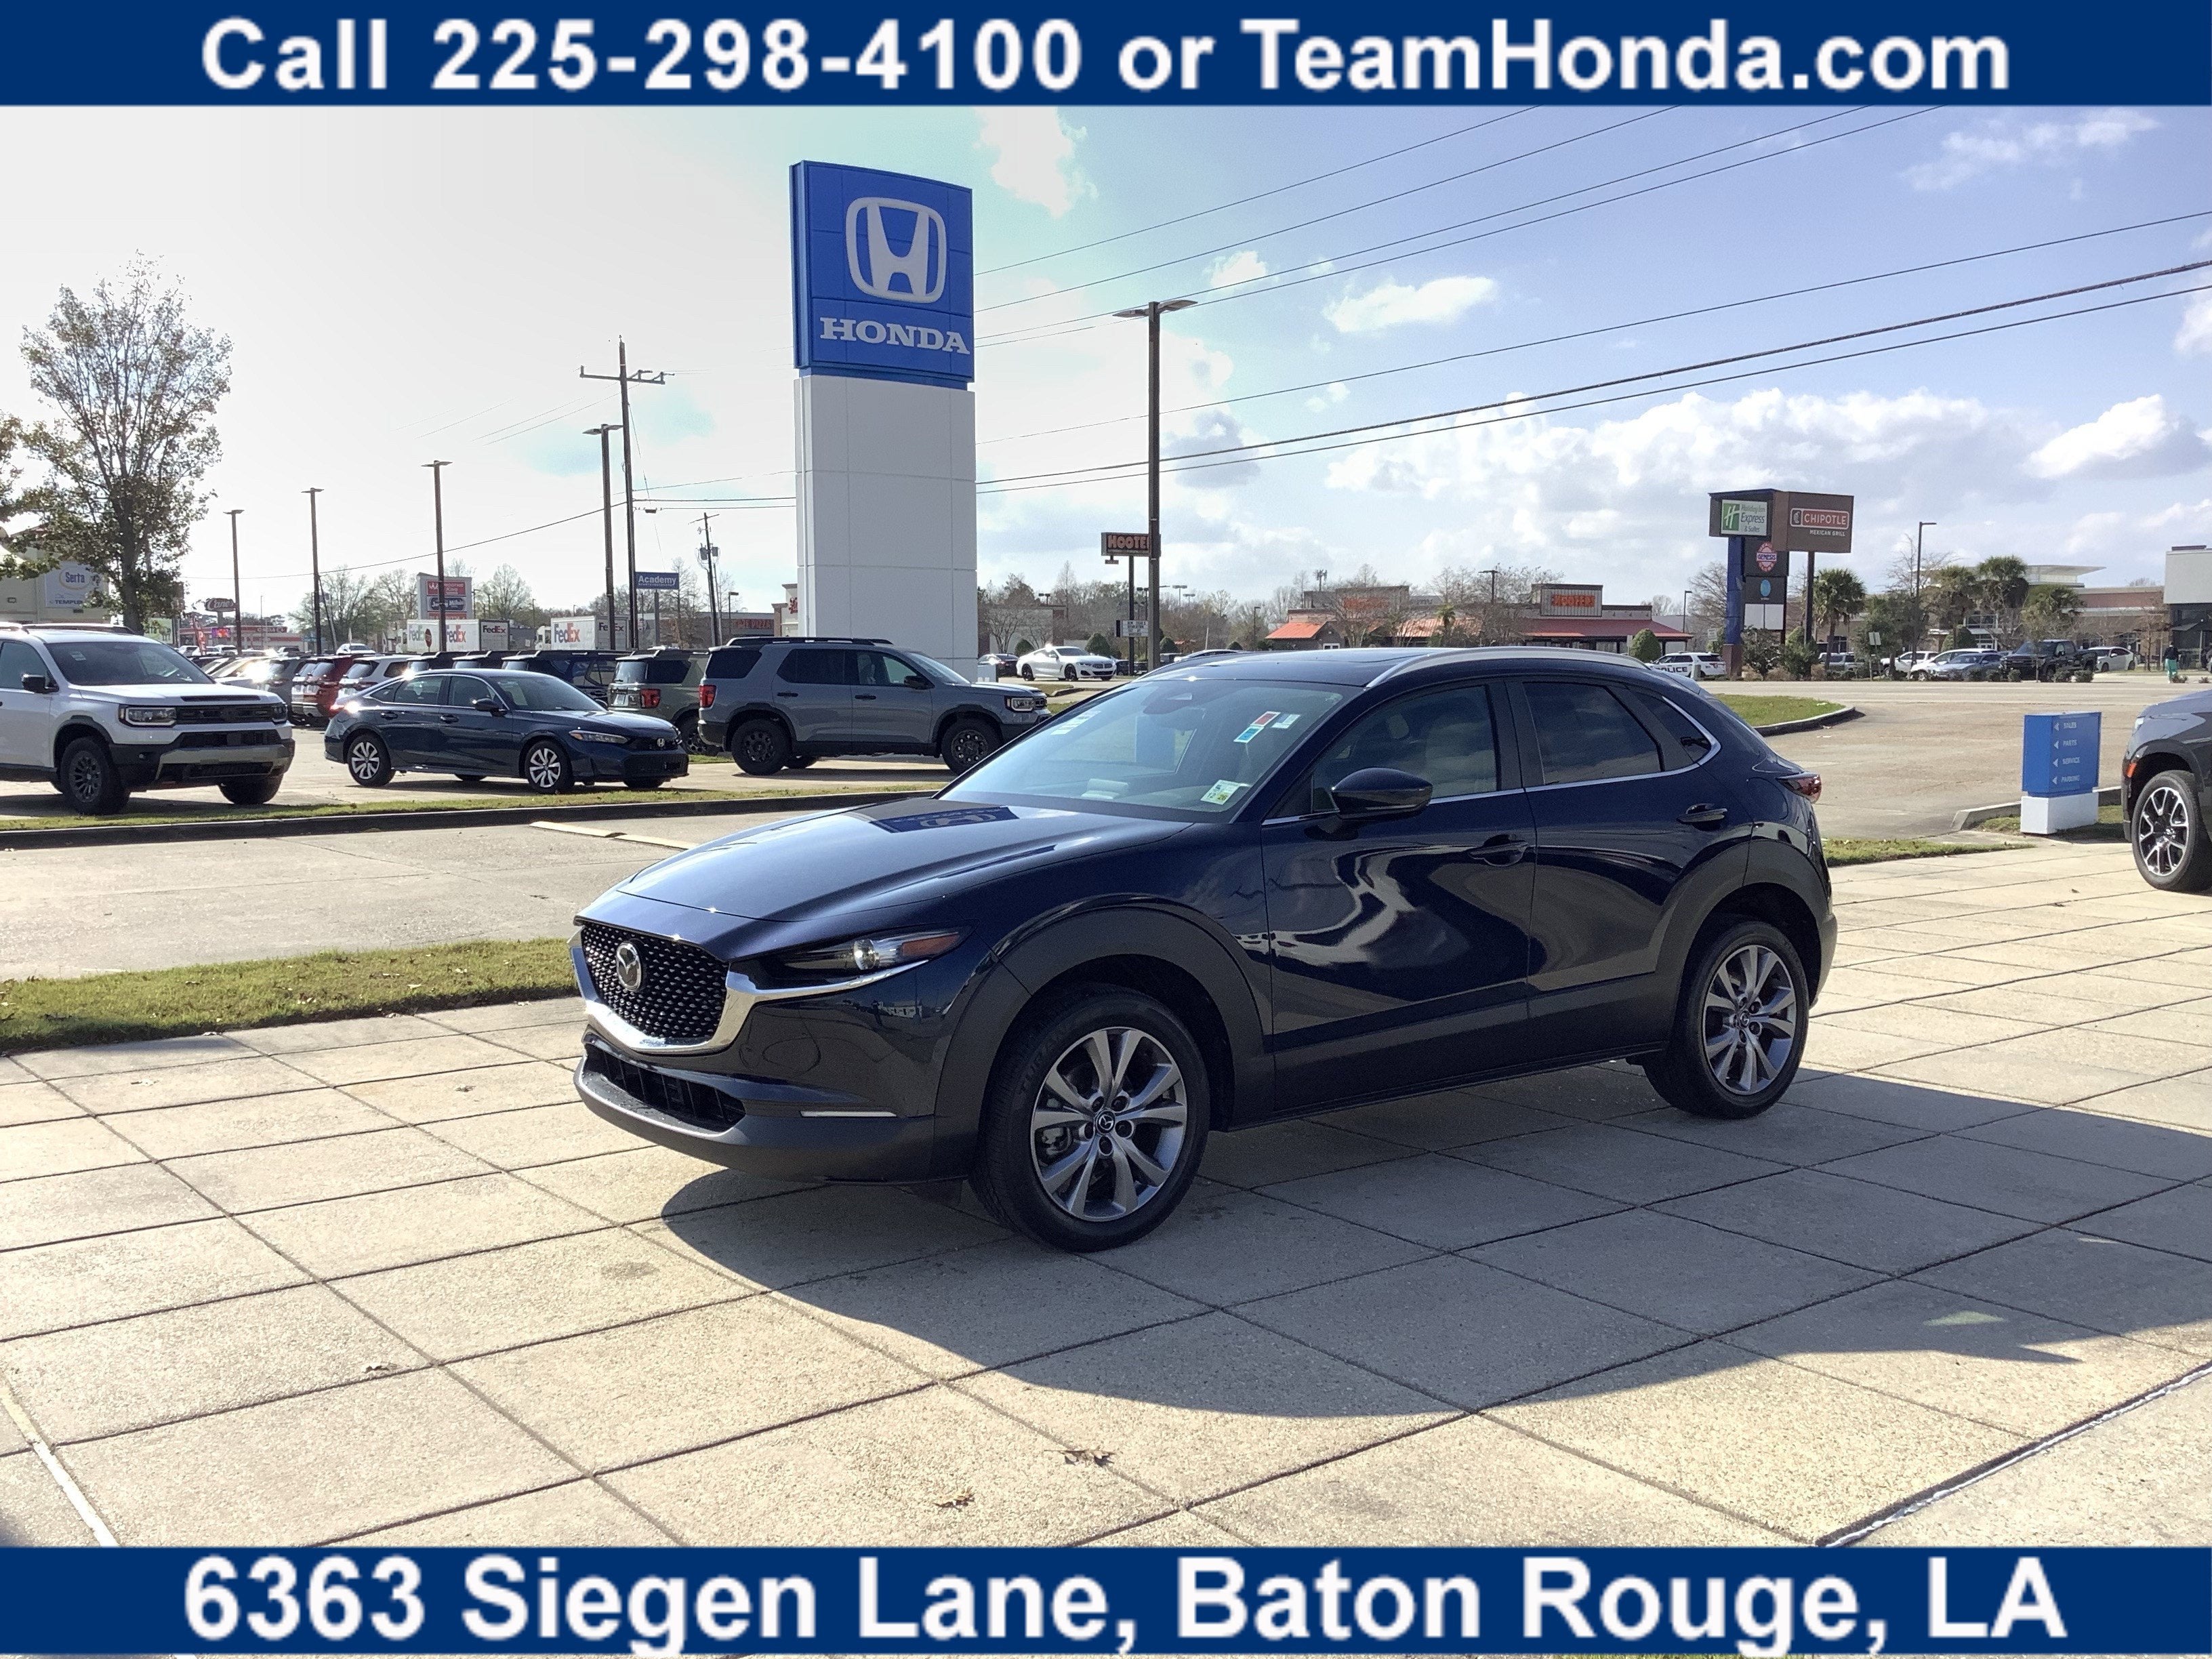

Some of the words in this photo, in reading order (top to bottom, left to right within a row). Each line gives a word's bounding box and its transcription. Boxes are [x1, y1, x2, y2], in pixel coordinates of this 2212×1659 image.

[819, 316, 970, 355] HONDA
[1740, 512, 1765, 525] Express
[1804, 513, 1847, 525] CHIPOTLE
[1107, 534, 1149, 550] HOOTE
[65, 571, 85, 583] Serta
[638, 575, 677, 586] Academy
[483, 625, 506, 634] FedEx
[554, 622, 581, 643] FedEx
[598, 621, 624, 632] FeEx
